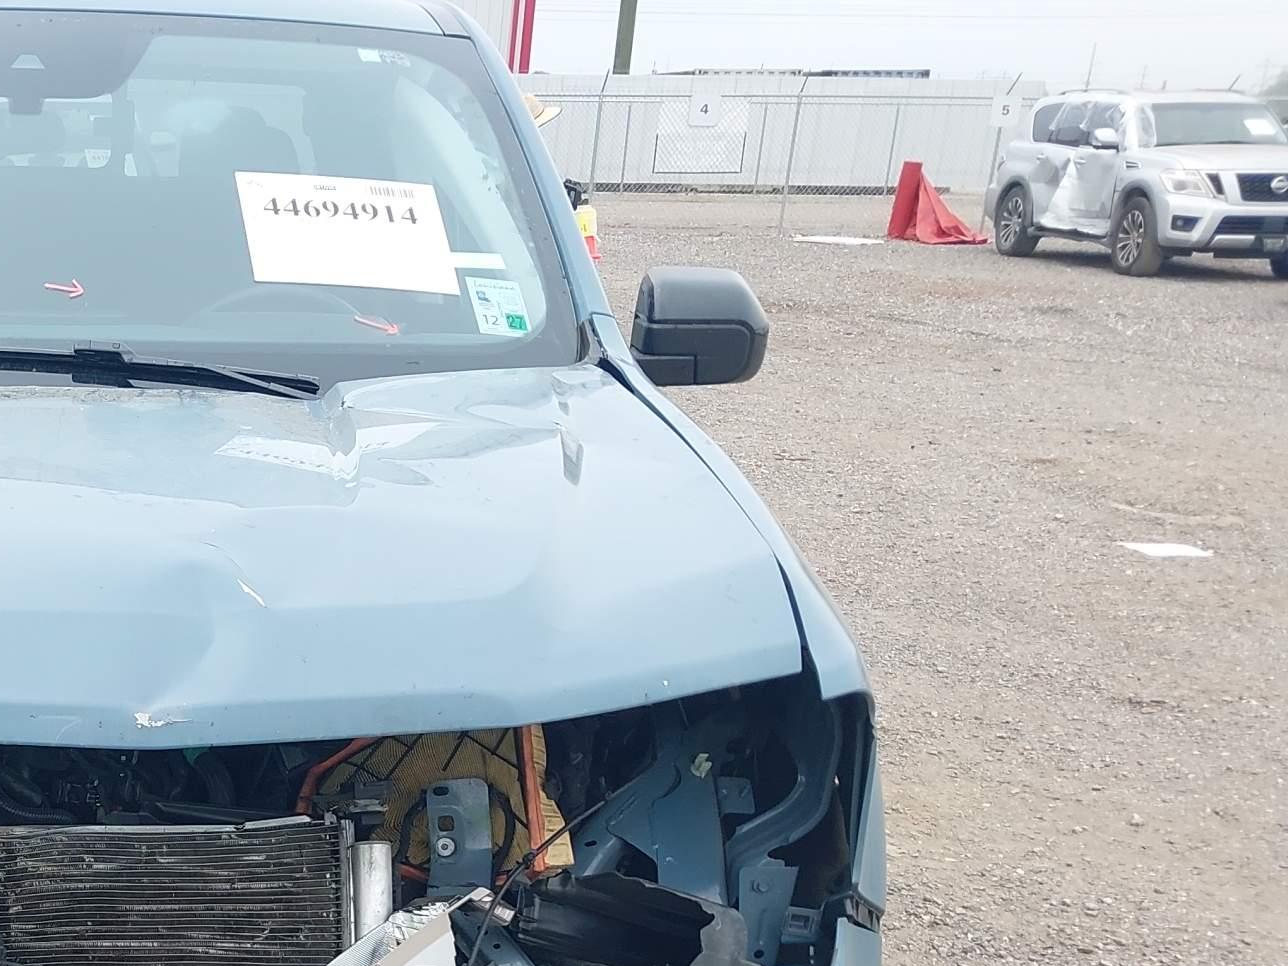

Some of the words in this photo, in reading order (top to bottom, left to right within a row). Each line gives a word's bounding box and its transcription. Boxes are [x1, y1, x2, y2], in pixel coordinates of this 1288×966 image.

[700, 103, 709, 114] 4
[1001, 104, 1010, 116] 5
[263, 197, 419, 225] 44694914
[482, 313, 500, 326] 12
[506, 314, 523, 330] 27
